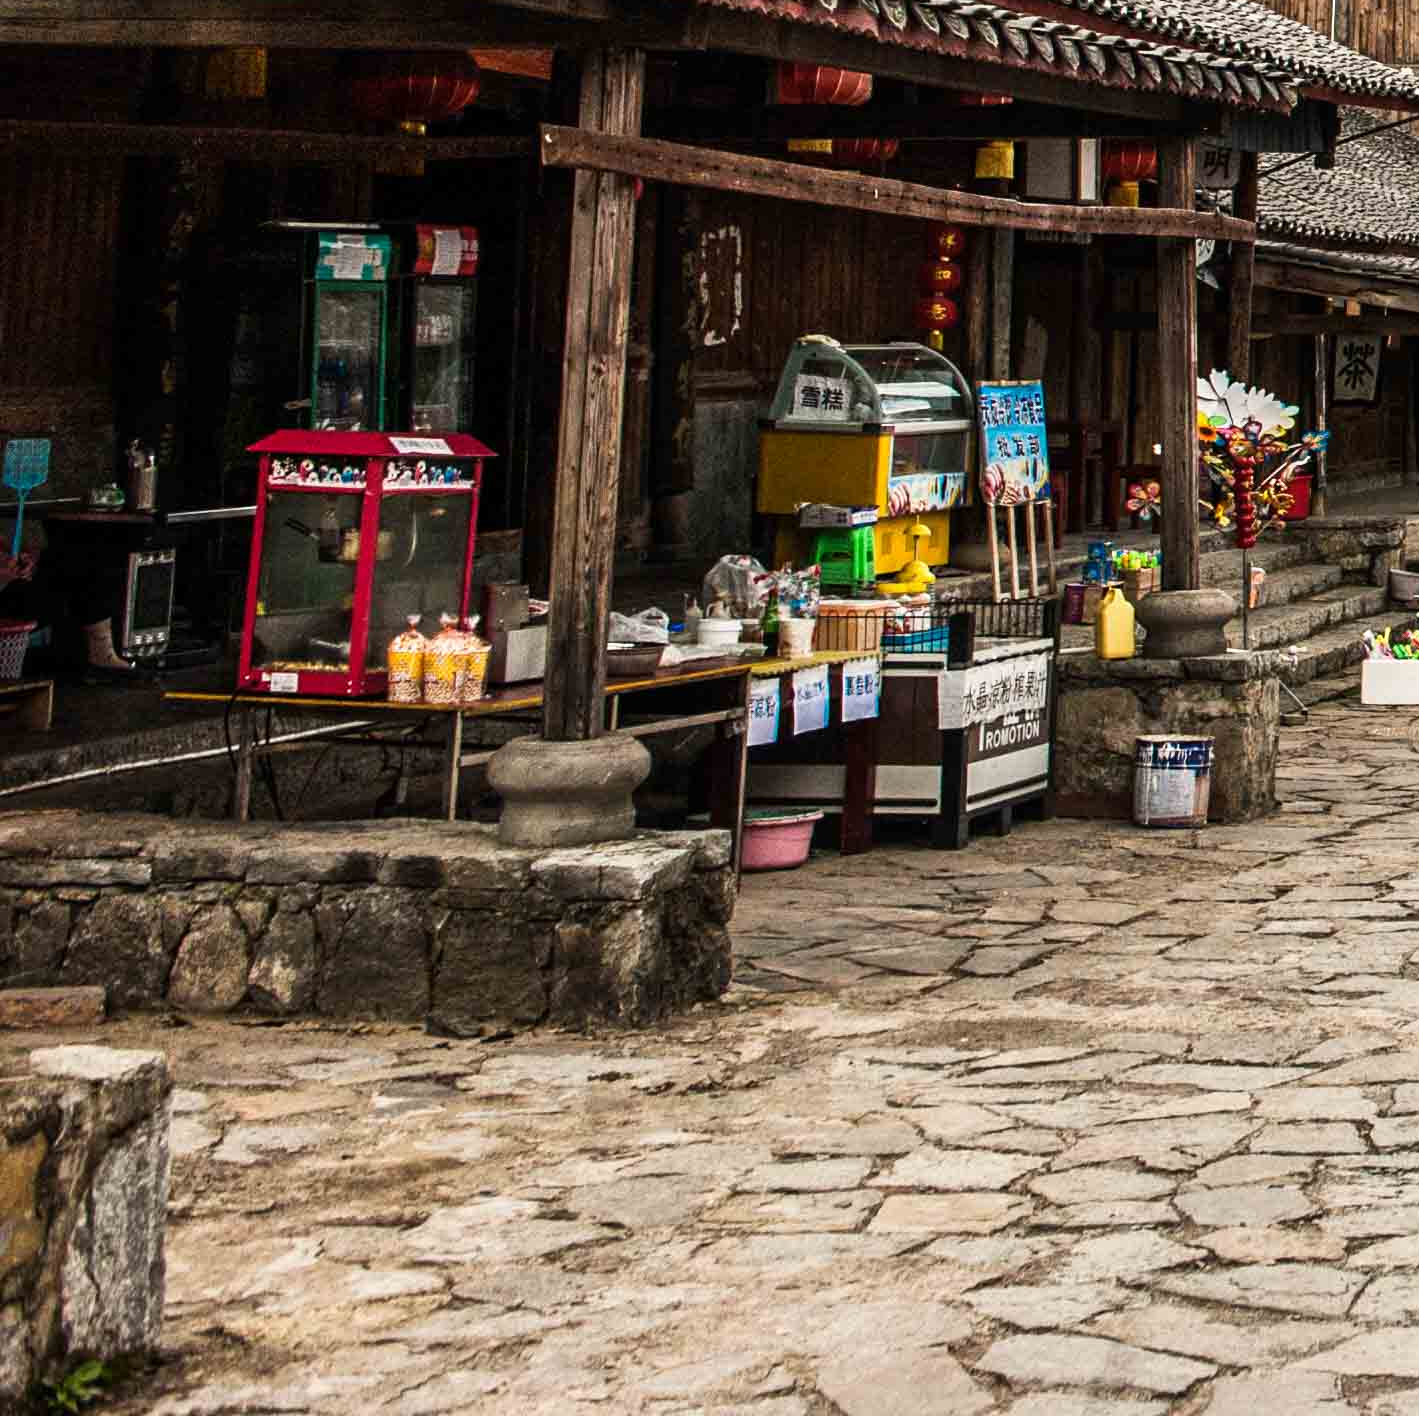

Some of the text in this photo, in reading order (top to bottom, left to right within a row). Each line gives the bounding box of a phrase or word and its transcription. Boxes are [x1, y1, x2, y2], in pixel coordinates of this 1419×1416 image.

[1337, 342, 1375, 390] 茶
[801, 386, 844, 410] 雪糕
[997, 434, 1041, 458] 批发部
